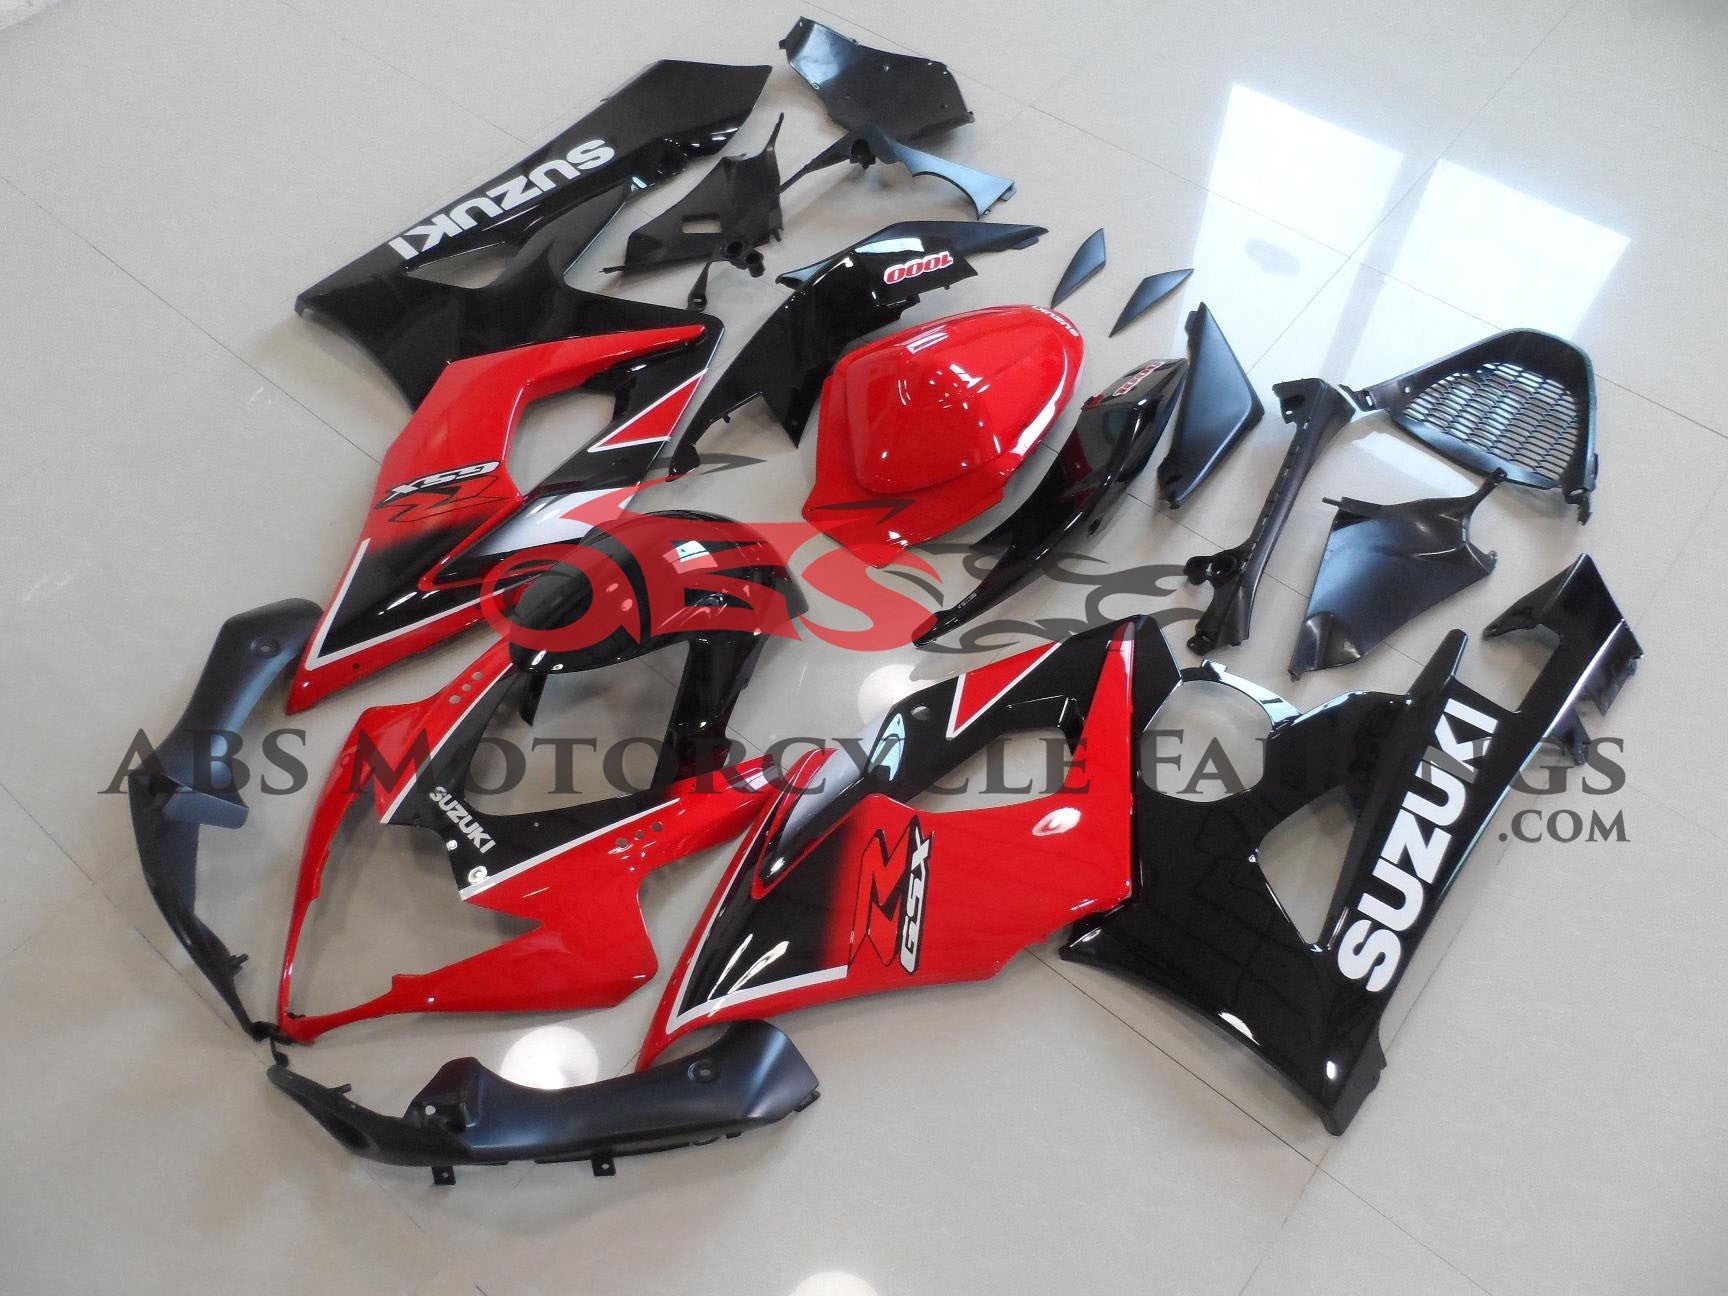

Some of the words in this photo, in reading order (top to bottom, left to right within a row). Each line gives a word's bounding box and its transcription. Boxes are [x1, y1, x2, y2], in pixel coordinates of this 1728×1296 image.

[388, 139, 615, 260] SUZUKI
[883, 250, 954, 285] 1000
[429, 786, 497, 854] SUZUKI
[1337, 698, 1499, 993] SUZUKI
[900, 824, 931, 974] GSX
